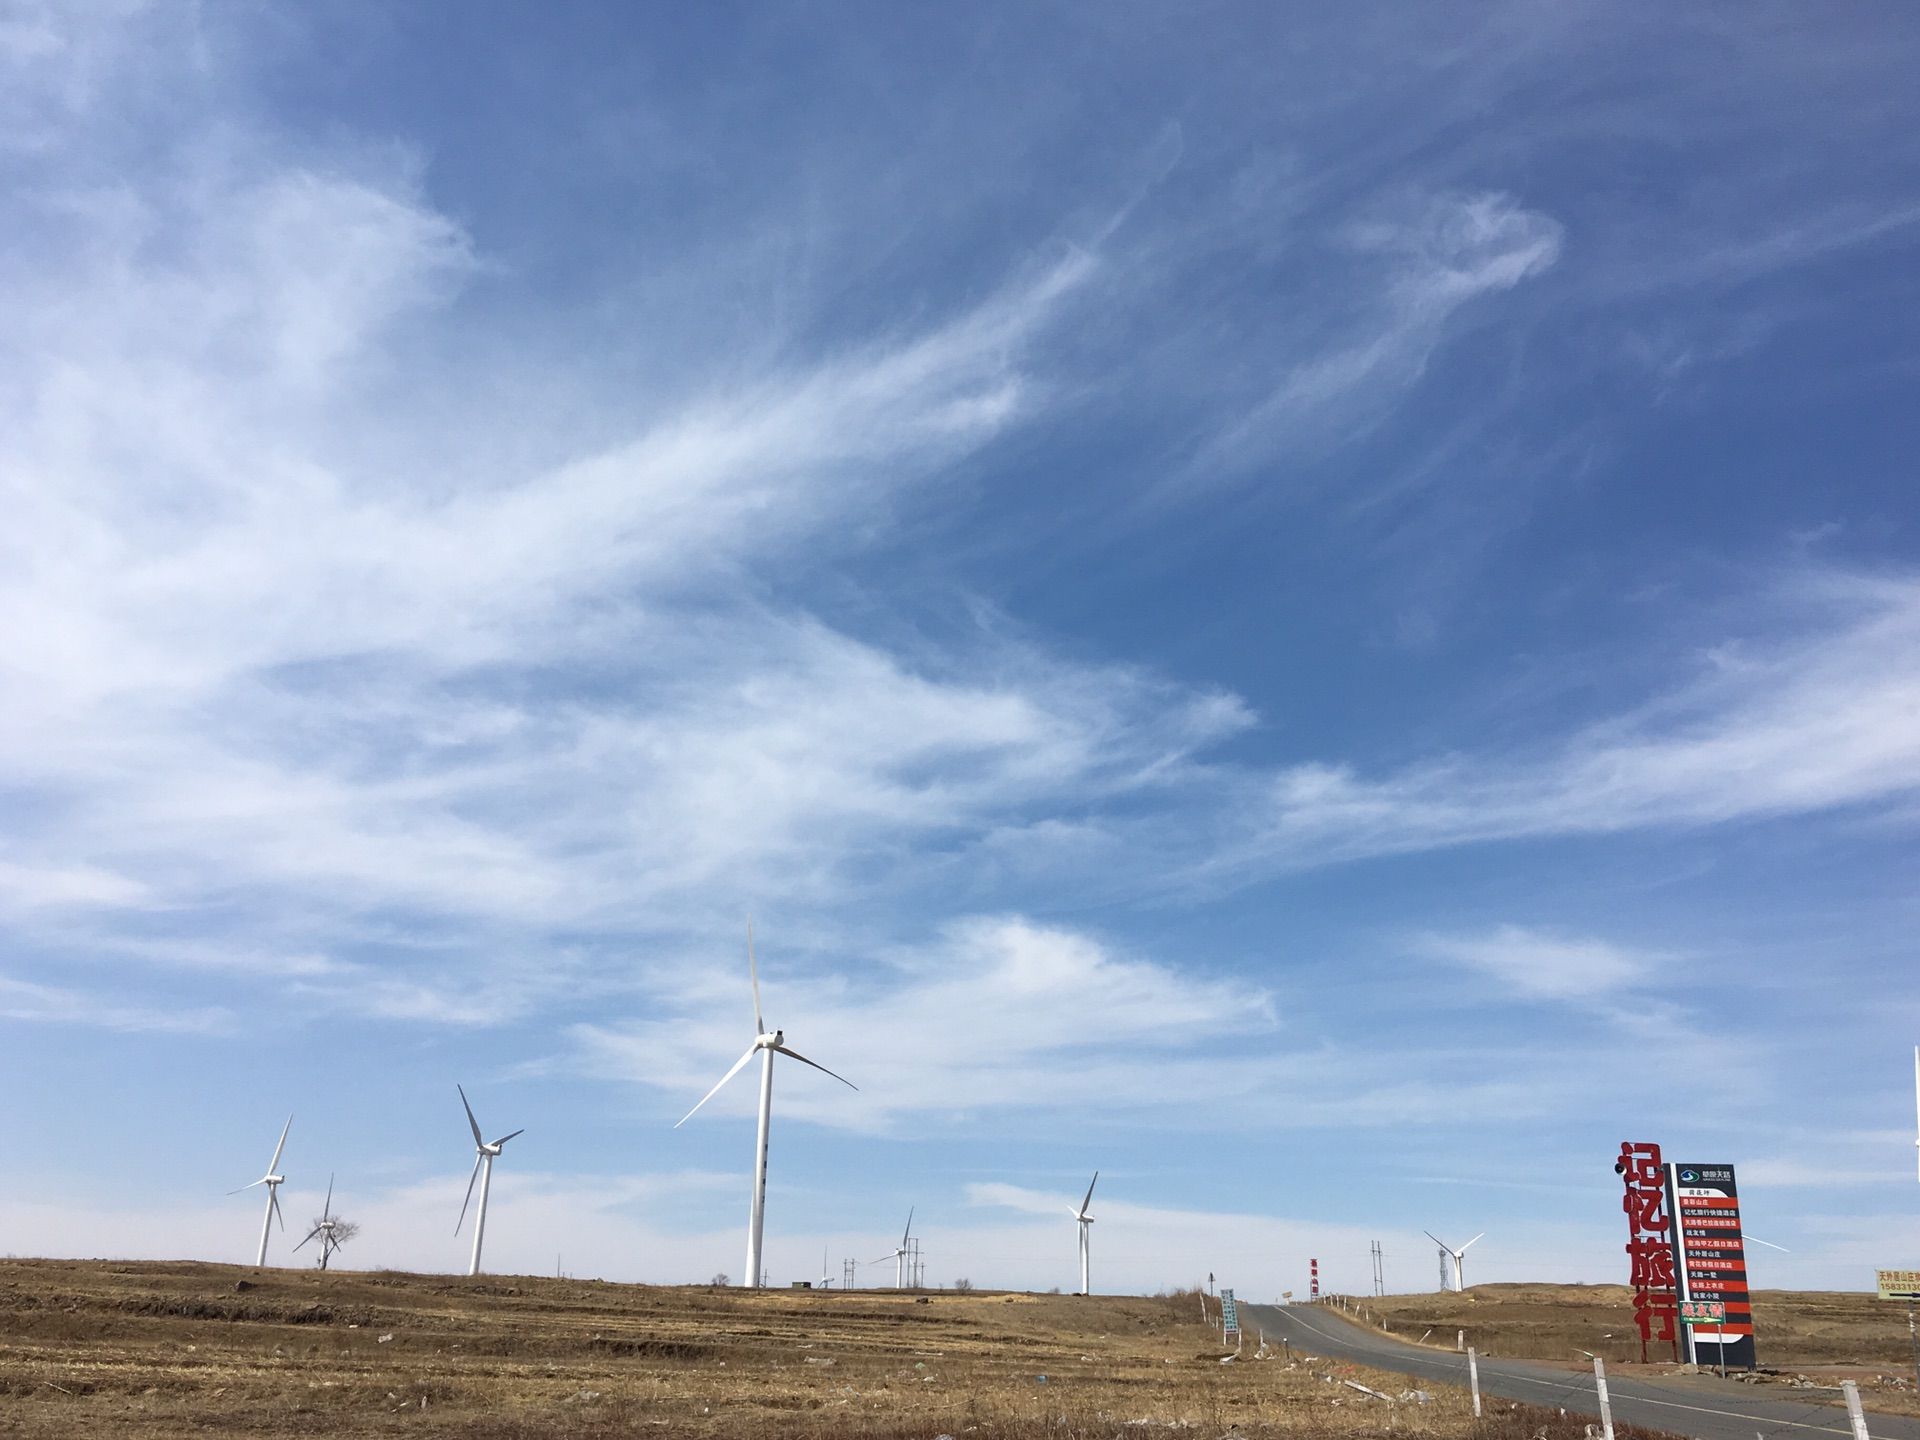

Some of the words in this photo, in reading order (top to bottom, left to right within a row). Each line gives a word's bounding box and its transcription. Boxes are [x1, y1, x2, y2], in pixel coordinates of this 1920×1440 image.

[1618, 1141, 1679, 1341] 记忆旅行
[1684, 1209, 1736, 1217] 记忆旅行快捷酒店
